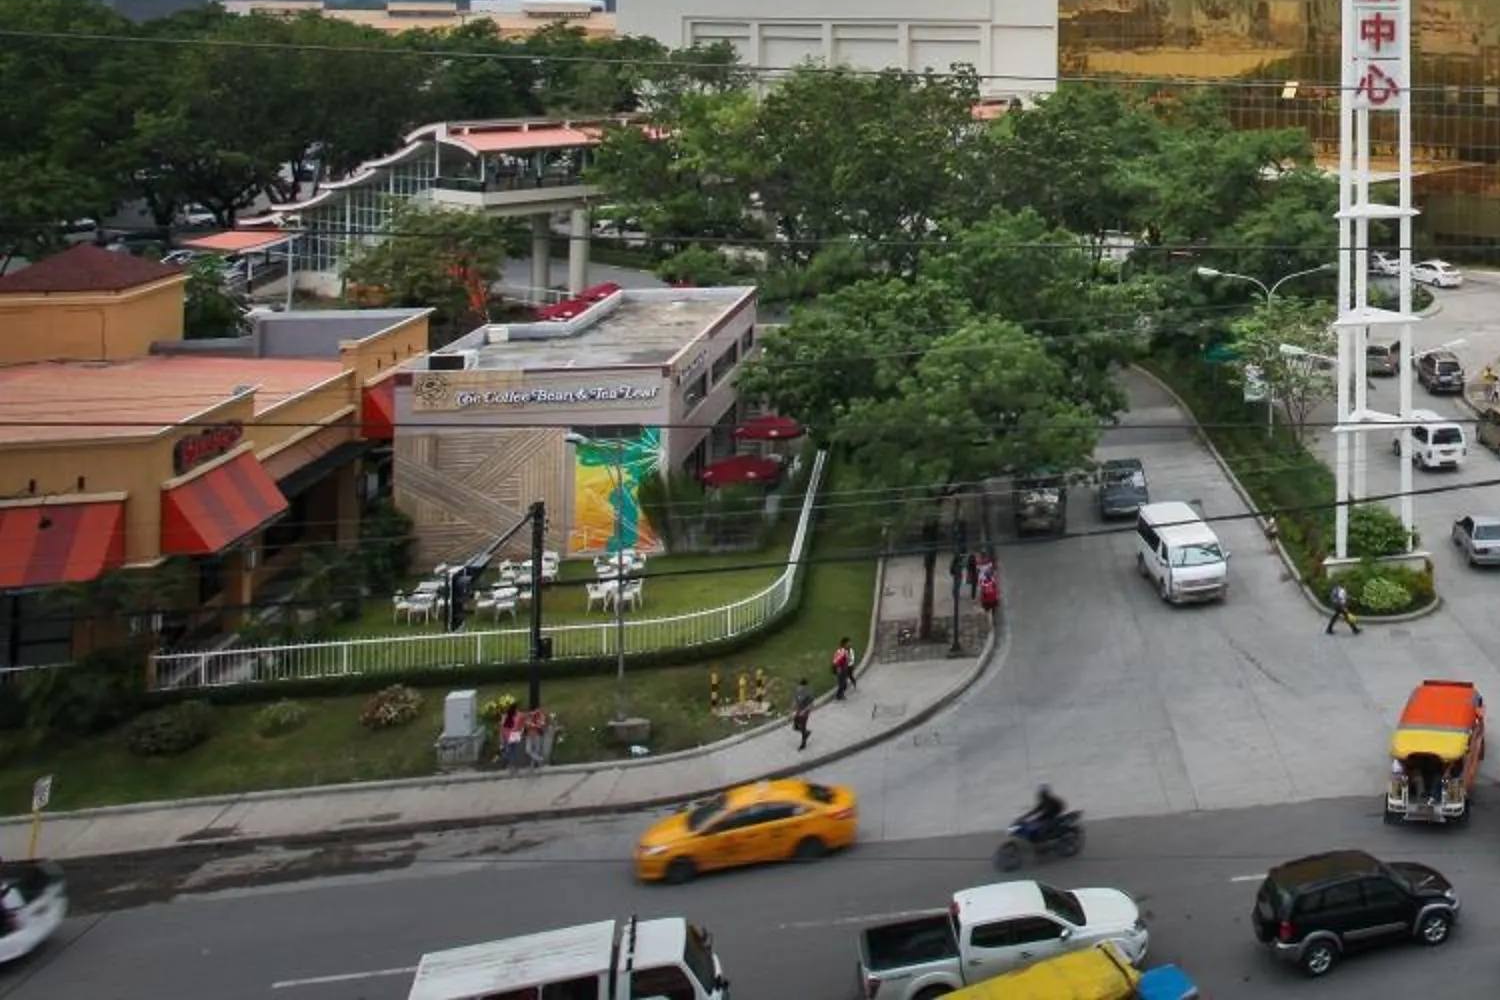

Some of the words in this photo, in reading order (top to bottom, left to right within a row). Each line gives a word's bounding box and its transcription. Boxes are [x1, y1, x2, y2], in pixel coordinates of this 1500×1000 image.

[484, 388, 531, 405] Coffee
[530, 387, 575, 404] Bean
[574, 386, 588, 401] &
[588, 386, 618, 401] Tea
[618, 385, 658, 400] Leaf
